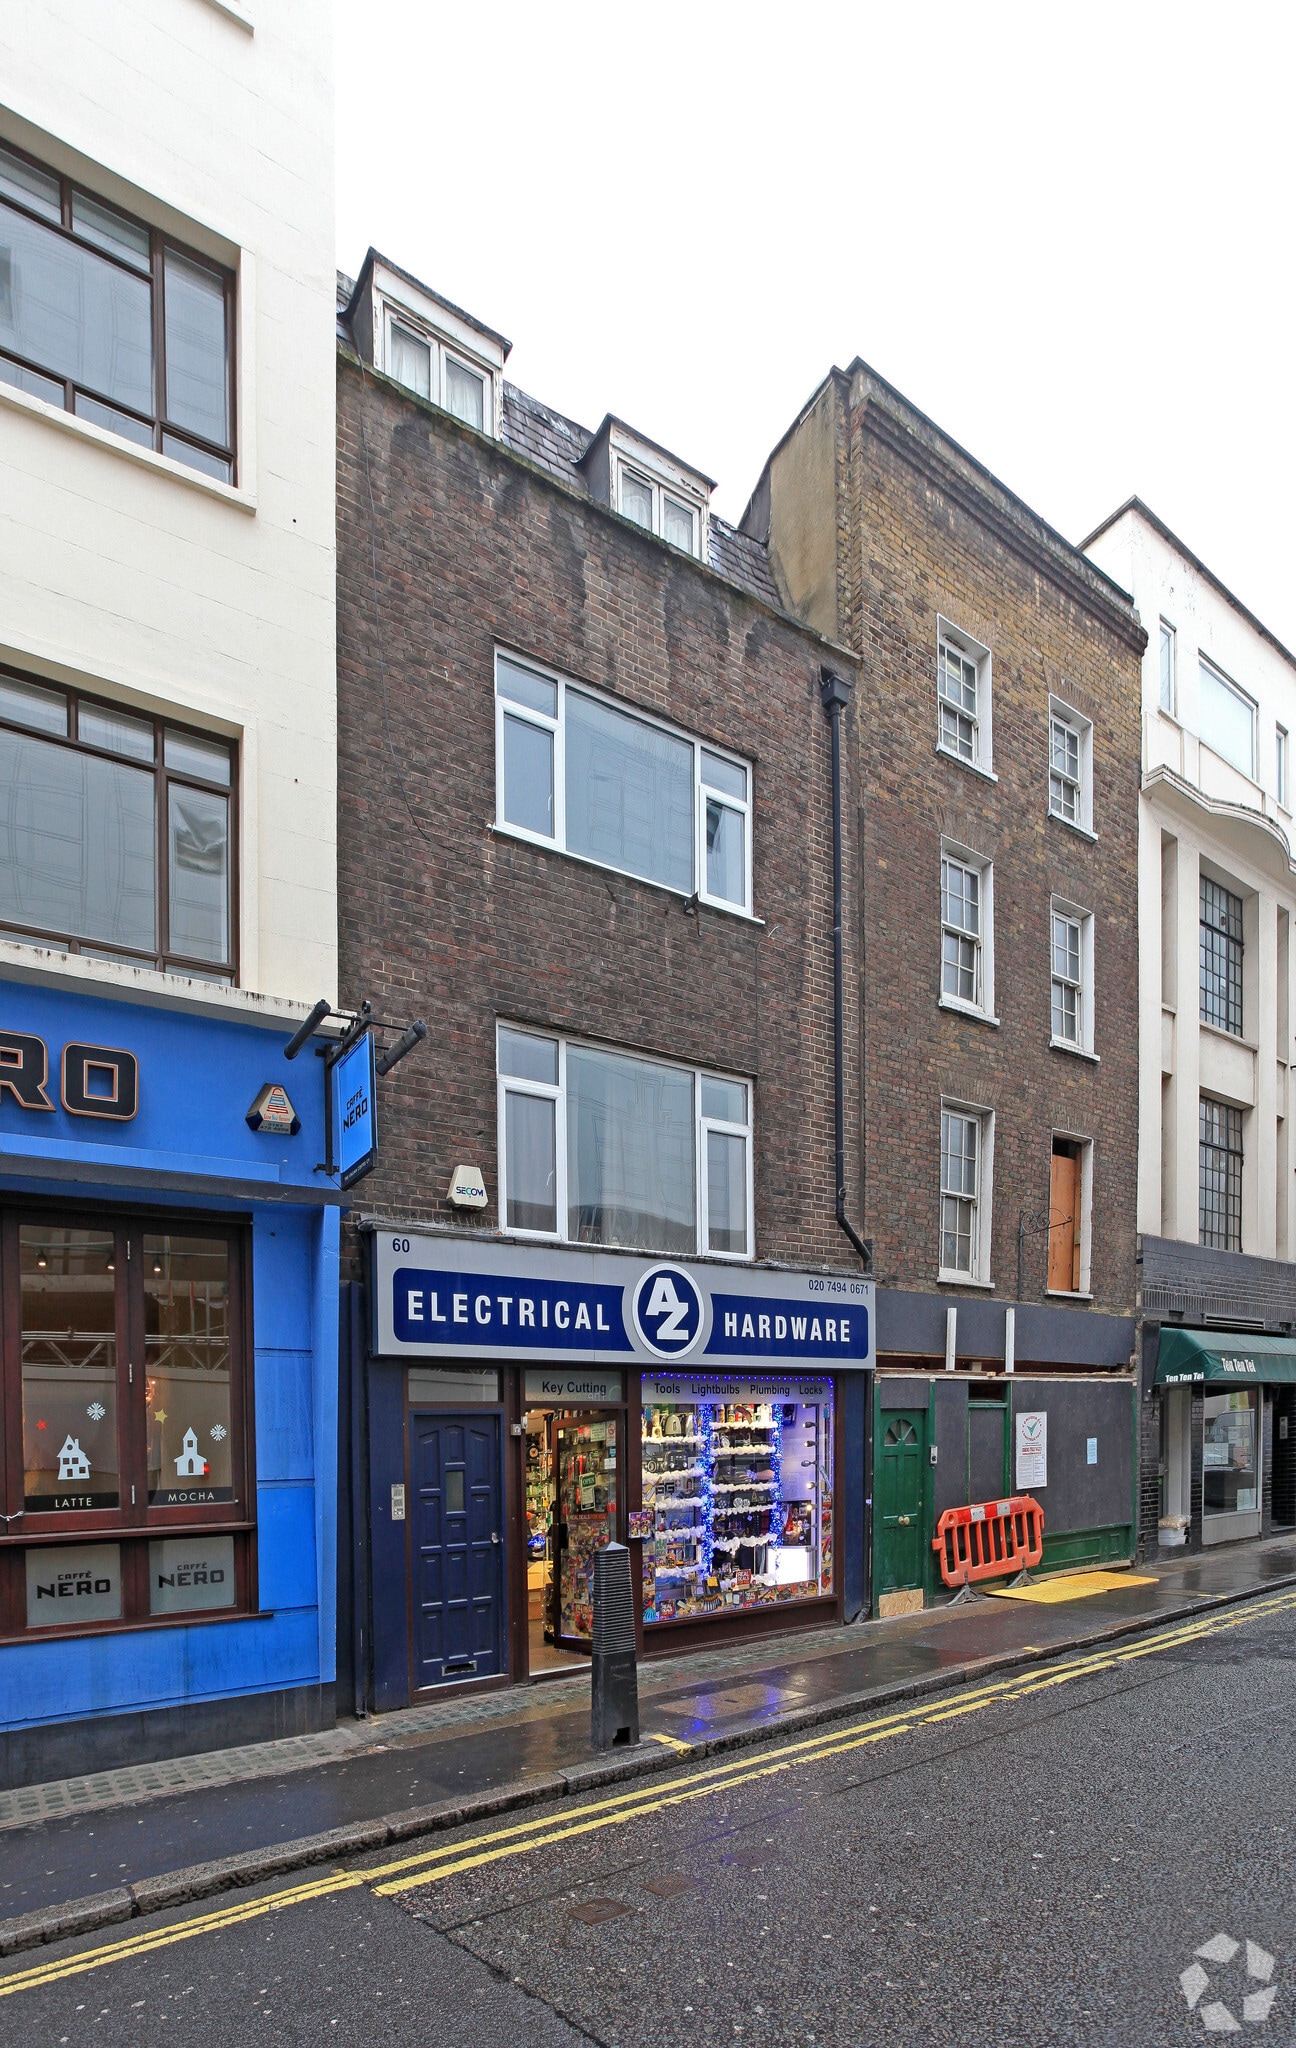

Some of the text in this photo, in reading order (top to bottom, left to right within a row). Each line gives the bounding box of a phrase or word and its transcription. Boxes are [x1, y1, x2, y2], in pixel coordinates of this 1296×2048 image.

[343, 1098, 368, 1133] NERO
[456, 1186, 484, 1197] SECOM
[392, 1238, 410, 1253] 60
[808, 1279, 869, 1296] 020 7494 0671
[407, 1290, 610, 1331] ELECTRICAL
[724, 1312, 850, 1342] HARDWARE
[1221, 1358, 1235, 1372] Ten
[1233, 1358, 1245, 1372] Ten
[1165, 1374, 1179, 1383] Ten
[1180, 1373, 1193, 1382] Ten
[542, 1381, 607, 1396] Key Cutting
[654, 1382, 823, 1397] Tools Lightbulbs Plumbing Locks
[583, 1477, 595, 1485] OPEN
[55, 1497, 93, 1508] LATTE
[168, 1492, 215, 1502] MOCHA
[177, 1561, 207, 1571] CAFFÈ
[58, 1570, 92, 1580] CAFFÈ
[158, 1569, 225, 1588] NERO
[37, 1578, 111, 1599] NERO
